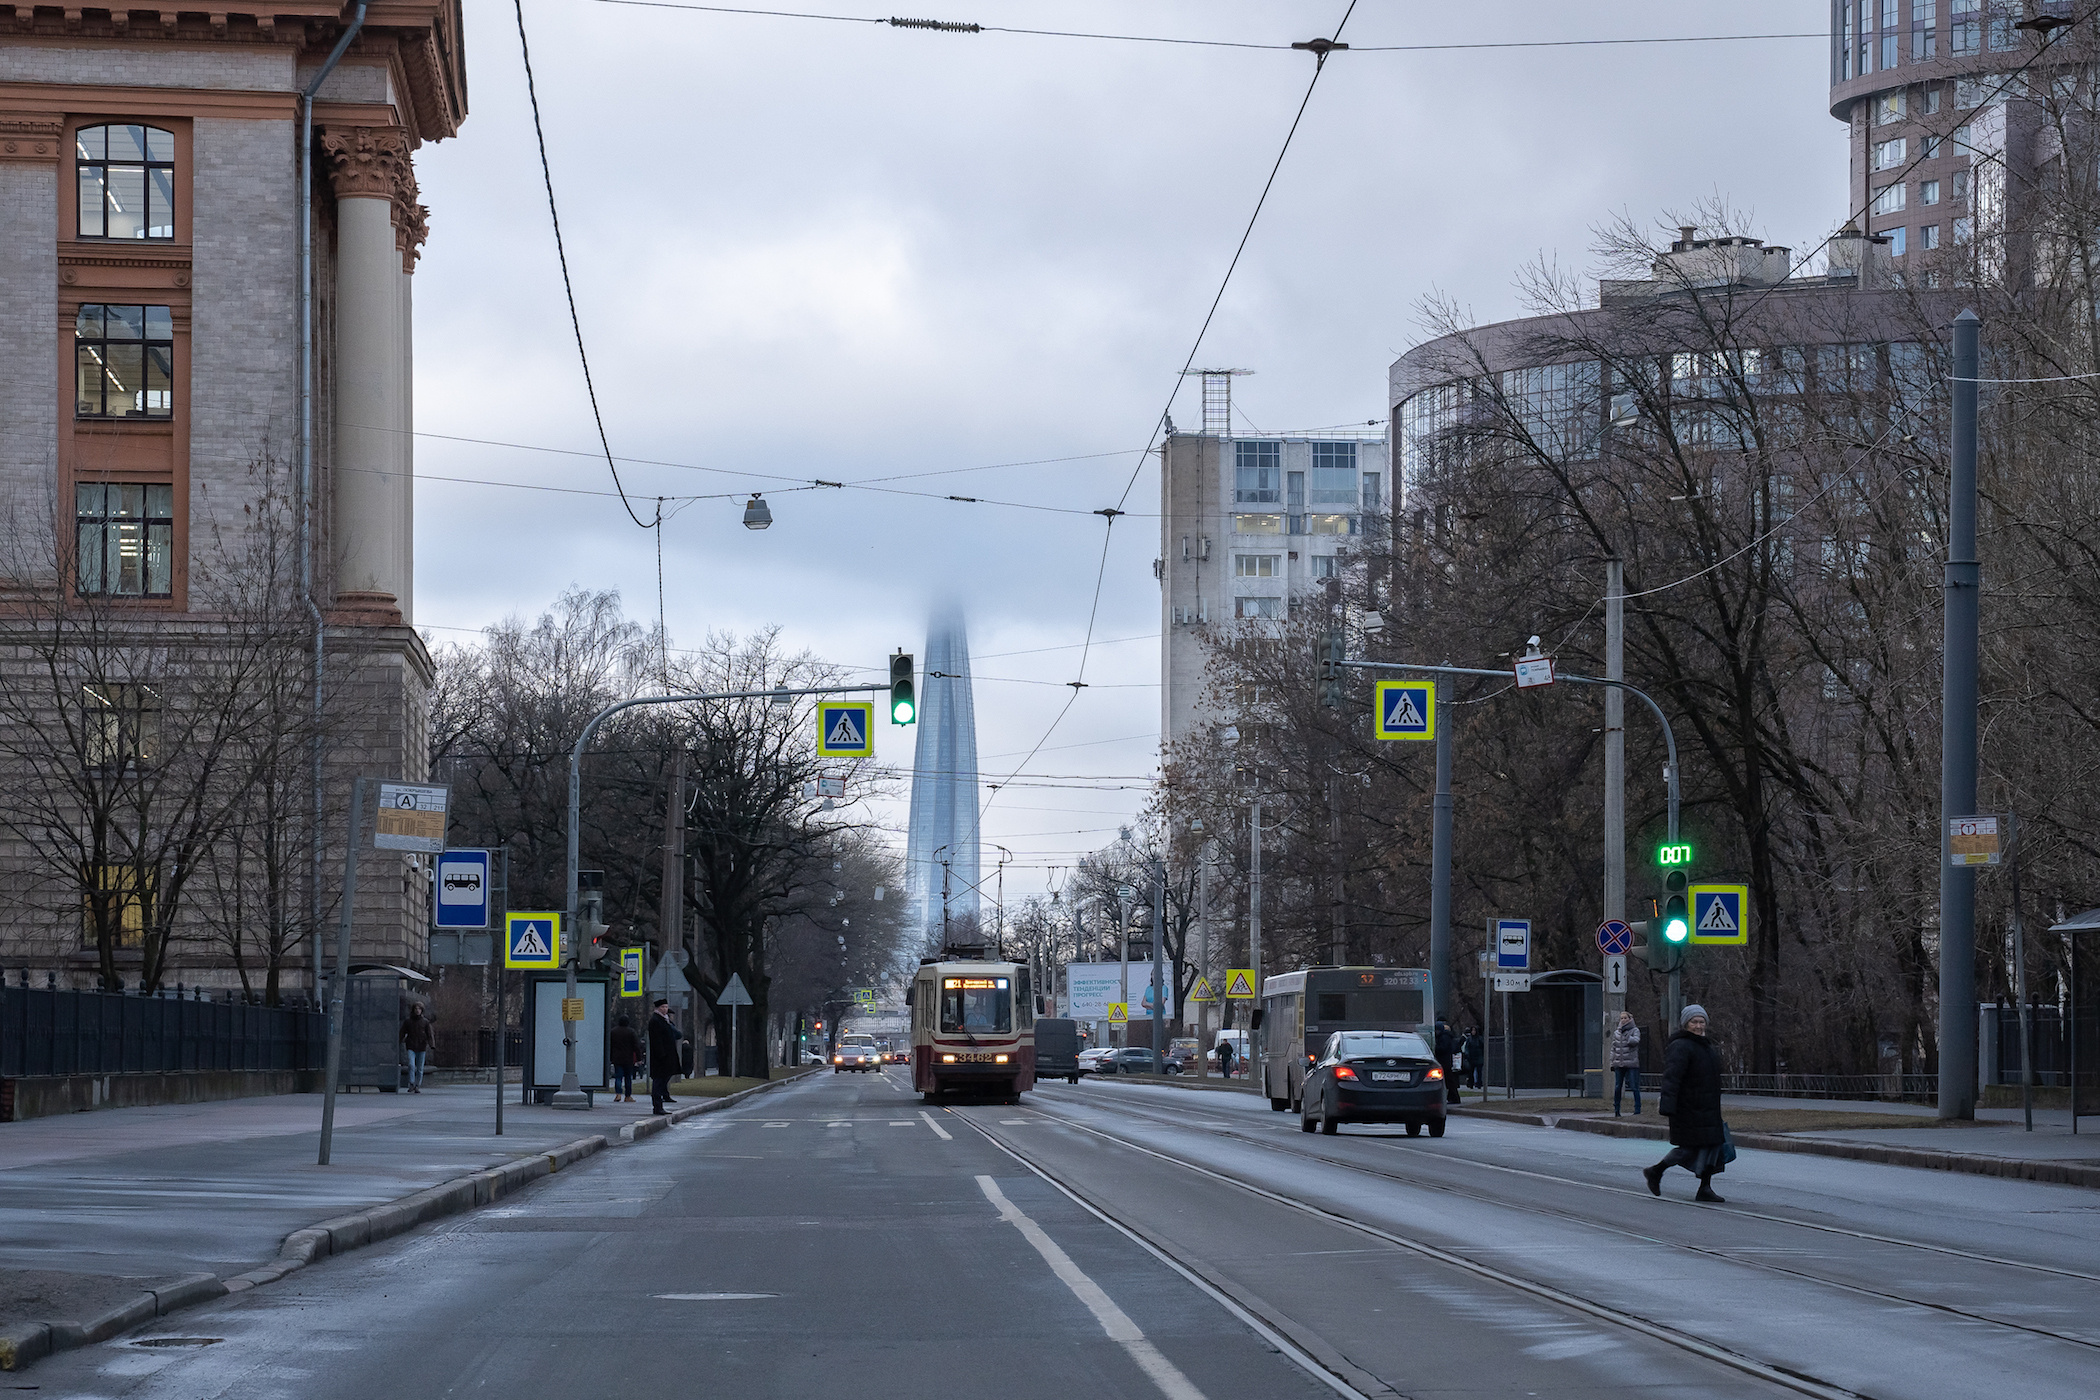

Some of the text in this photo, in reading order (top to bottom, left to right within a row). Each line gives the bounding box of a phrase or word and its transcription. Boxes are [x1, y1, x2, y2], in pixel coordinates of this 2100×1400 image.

[1361, 974, 1375, 984] 32
[1384, 977, 1398, 986] 320
[1399, 977, 1408, 985] 12
[1073, 985, 1111, 993] ТЕНДЕНЦИИ
[959, 1053, 992, 1063] 3462
